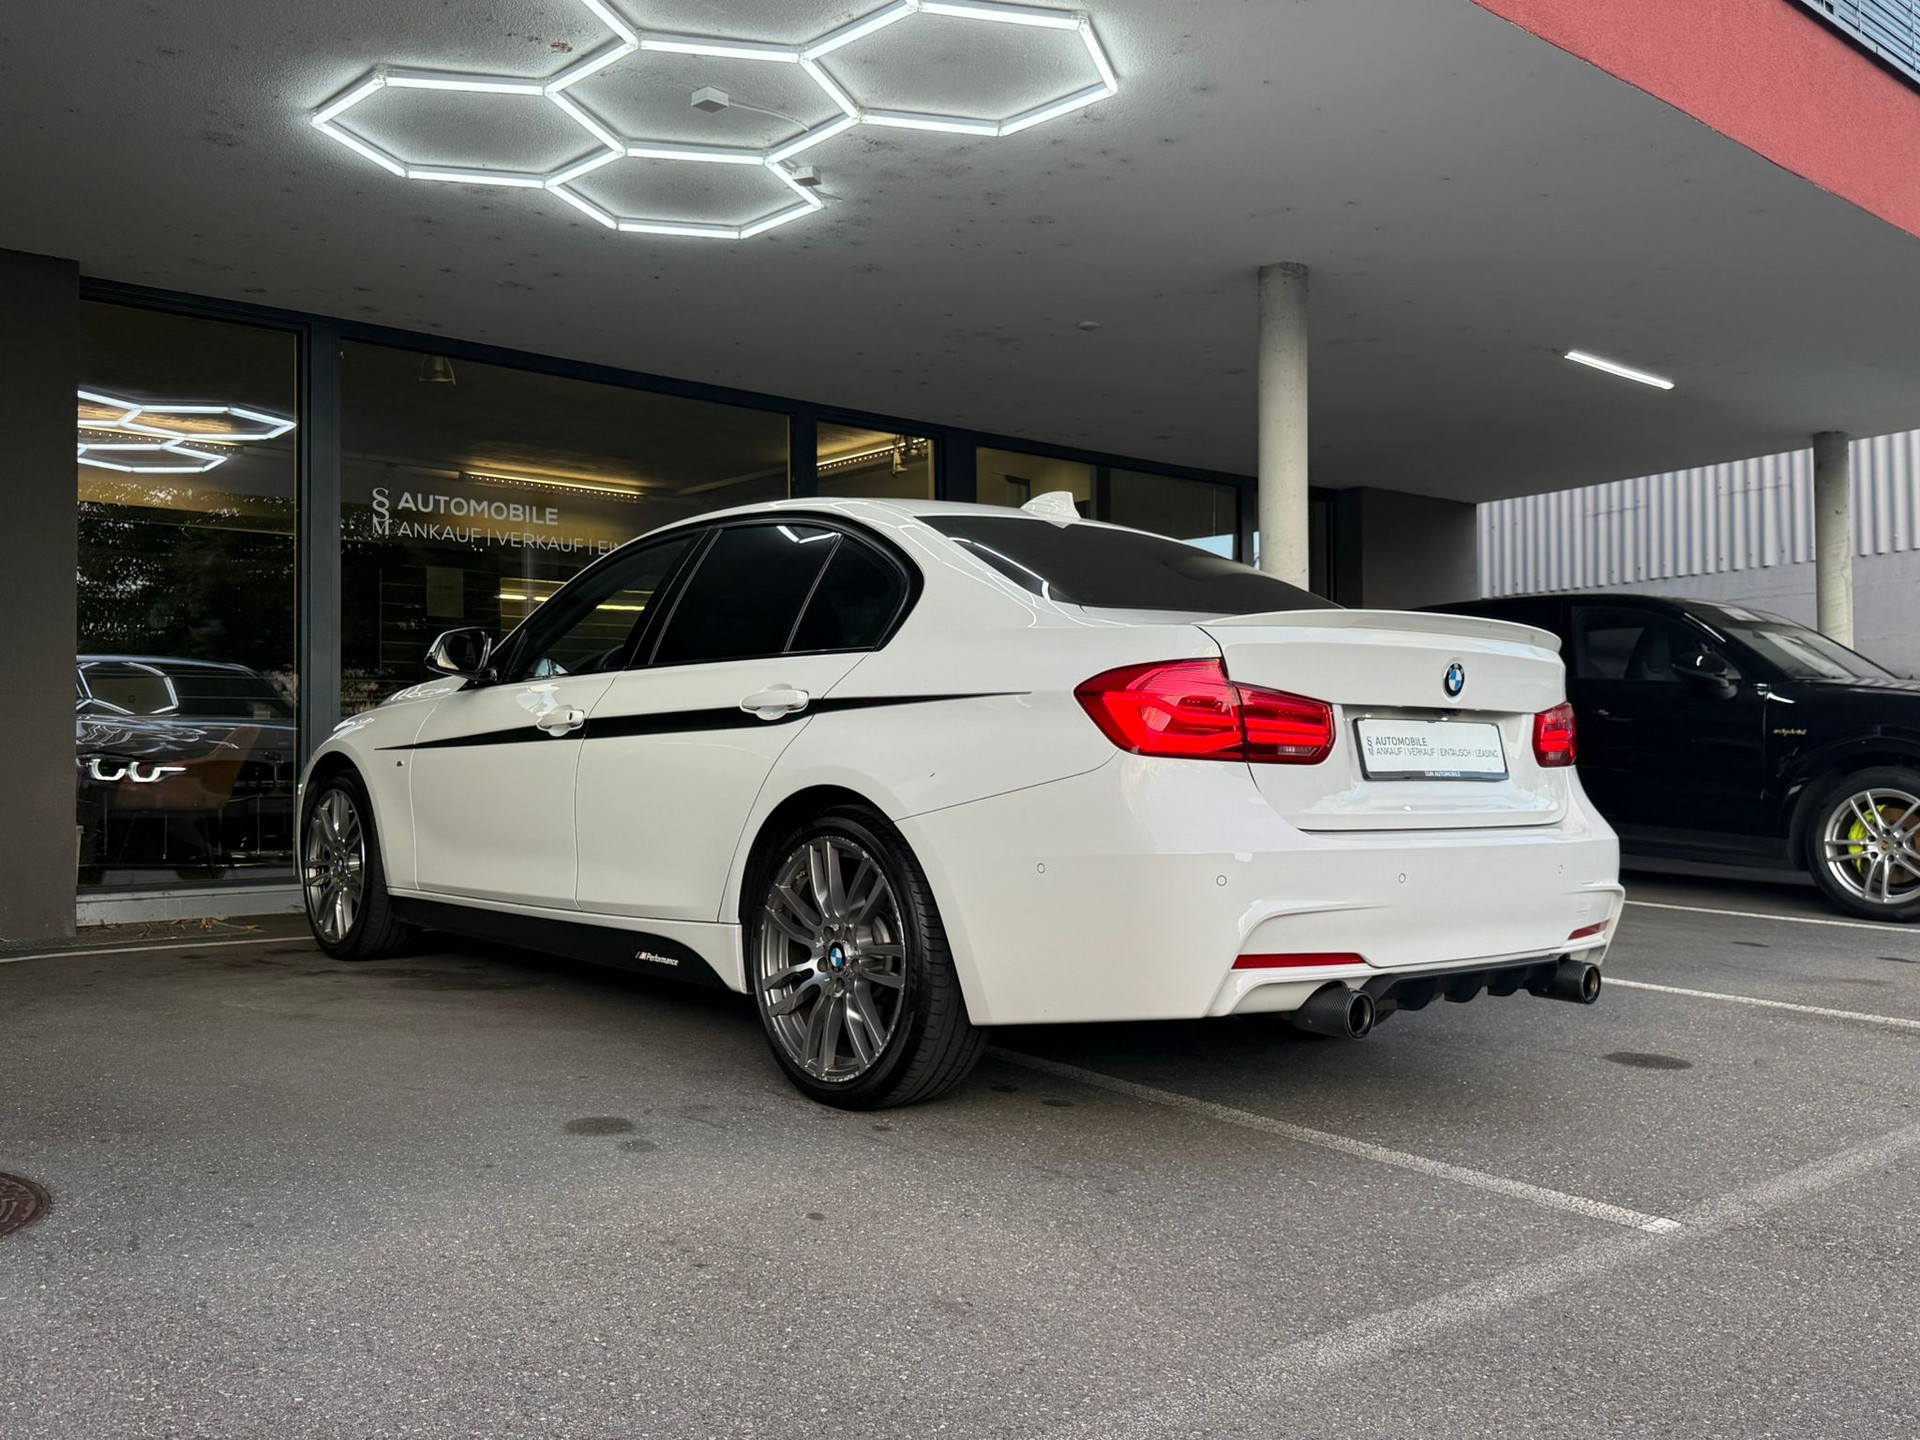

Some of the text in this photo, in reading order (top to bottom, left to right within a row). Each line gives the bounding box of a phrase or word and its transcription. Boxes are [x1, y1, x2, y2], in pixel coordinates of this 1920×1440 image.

[397, 491, 559, 526] AUTOMOBILE
[397, 521, 482, 543] ANKAUF
[496, 530, 584, 553] VERKAUF
[1375, 736, 1428, 747] AUTOMOBILE
[1376, 747, 1403, 756] ANKAUF
[1407, 747, 1436, 757] VERKAUF
[1475, 749, 1499, 758] LEASING
